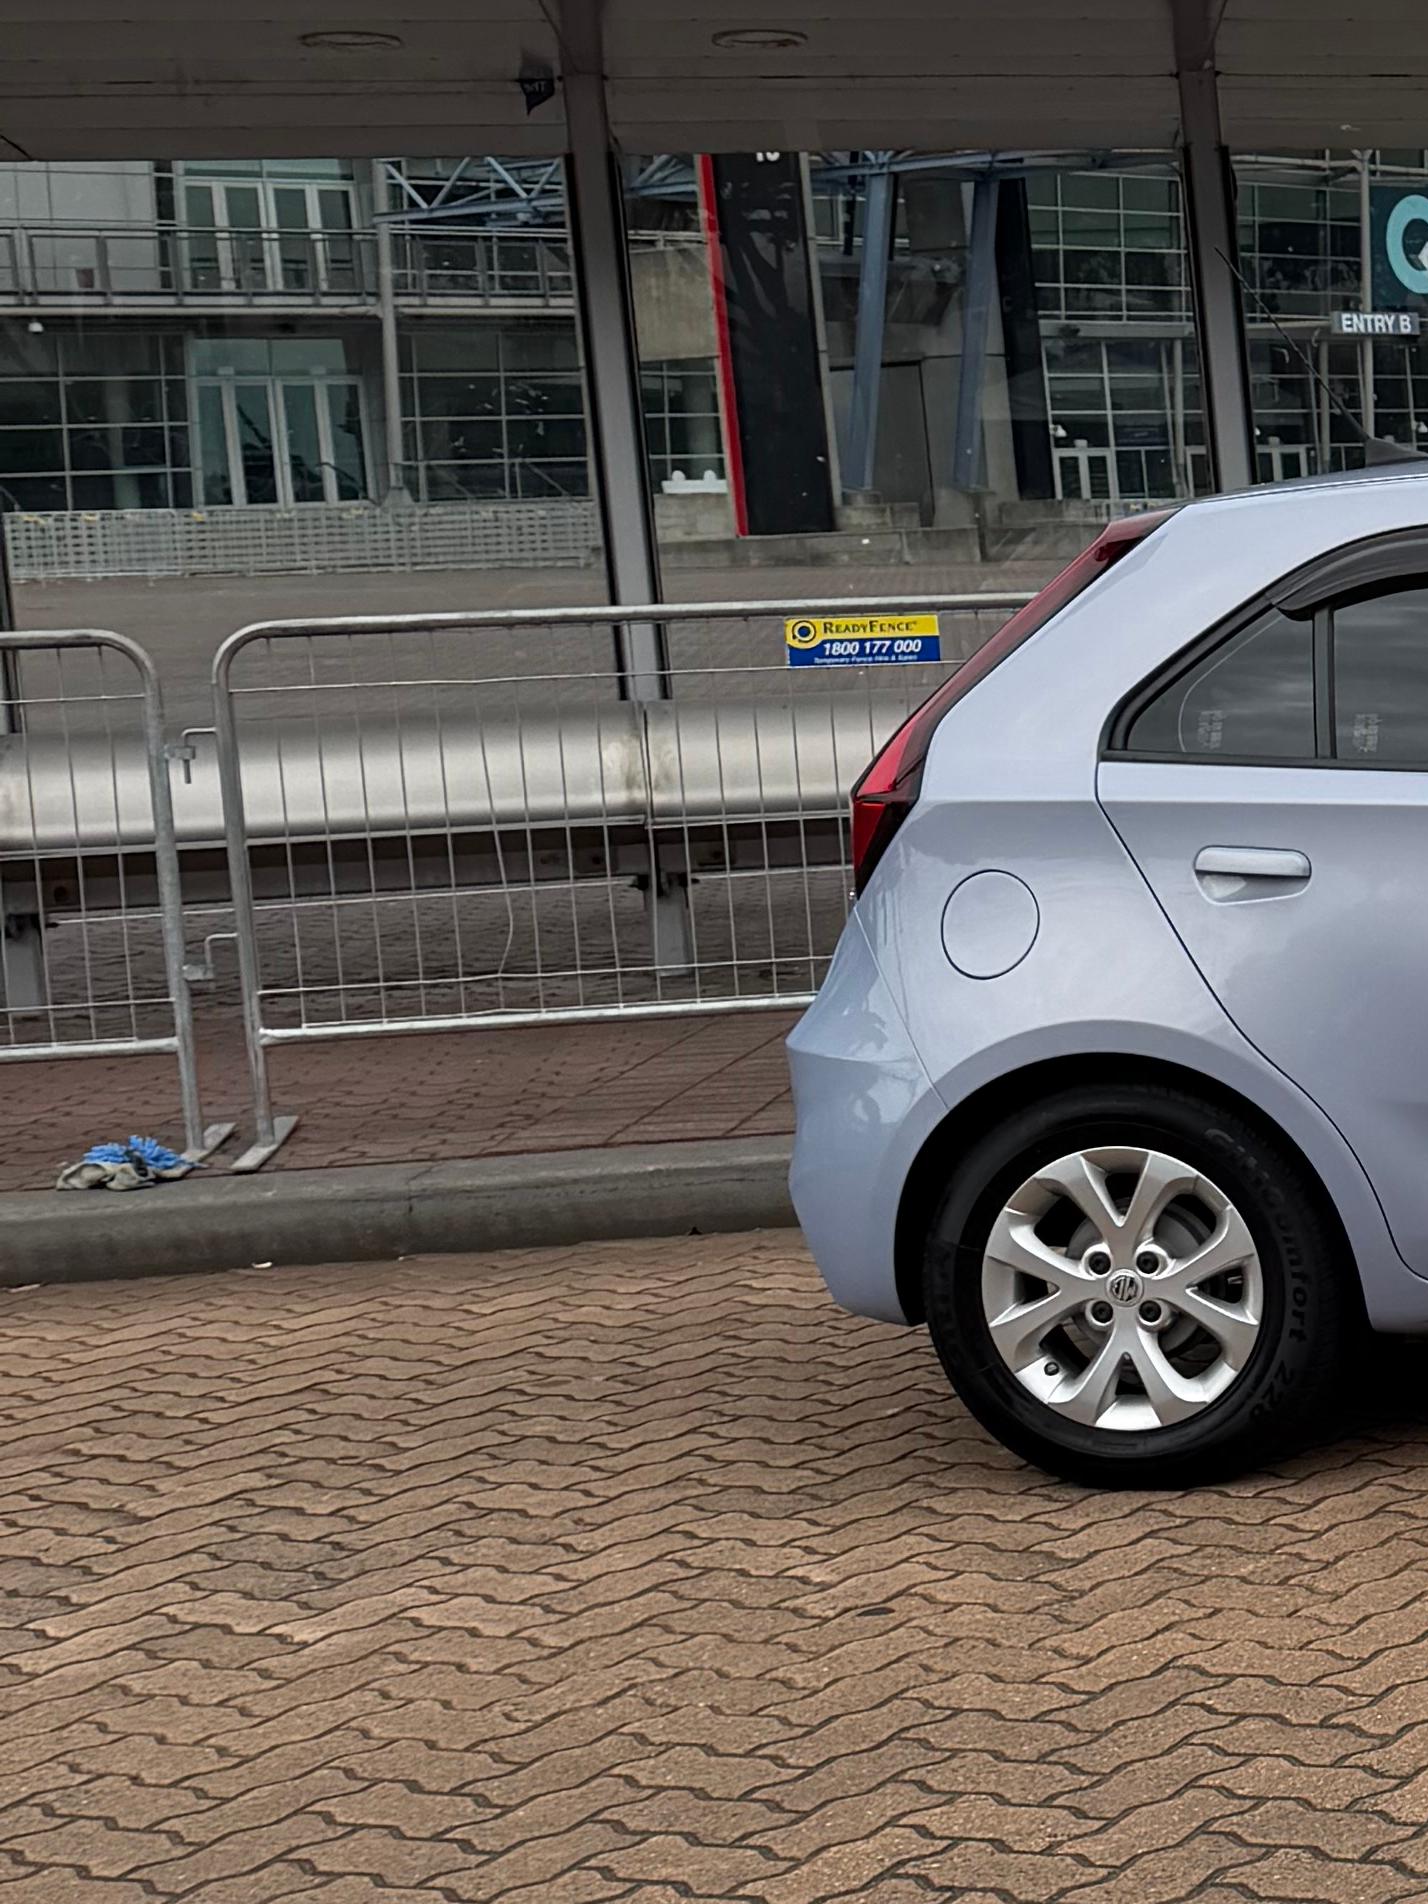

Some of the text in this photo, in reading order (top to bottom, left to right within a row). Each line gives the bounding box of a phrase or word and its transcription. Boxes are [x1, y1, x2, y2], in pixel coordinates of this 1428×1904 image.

[1341, 313, 1412, 333] ENTRY B
[823, 639, 922, 656] 1800 177 000
